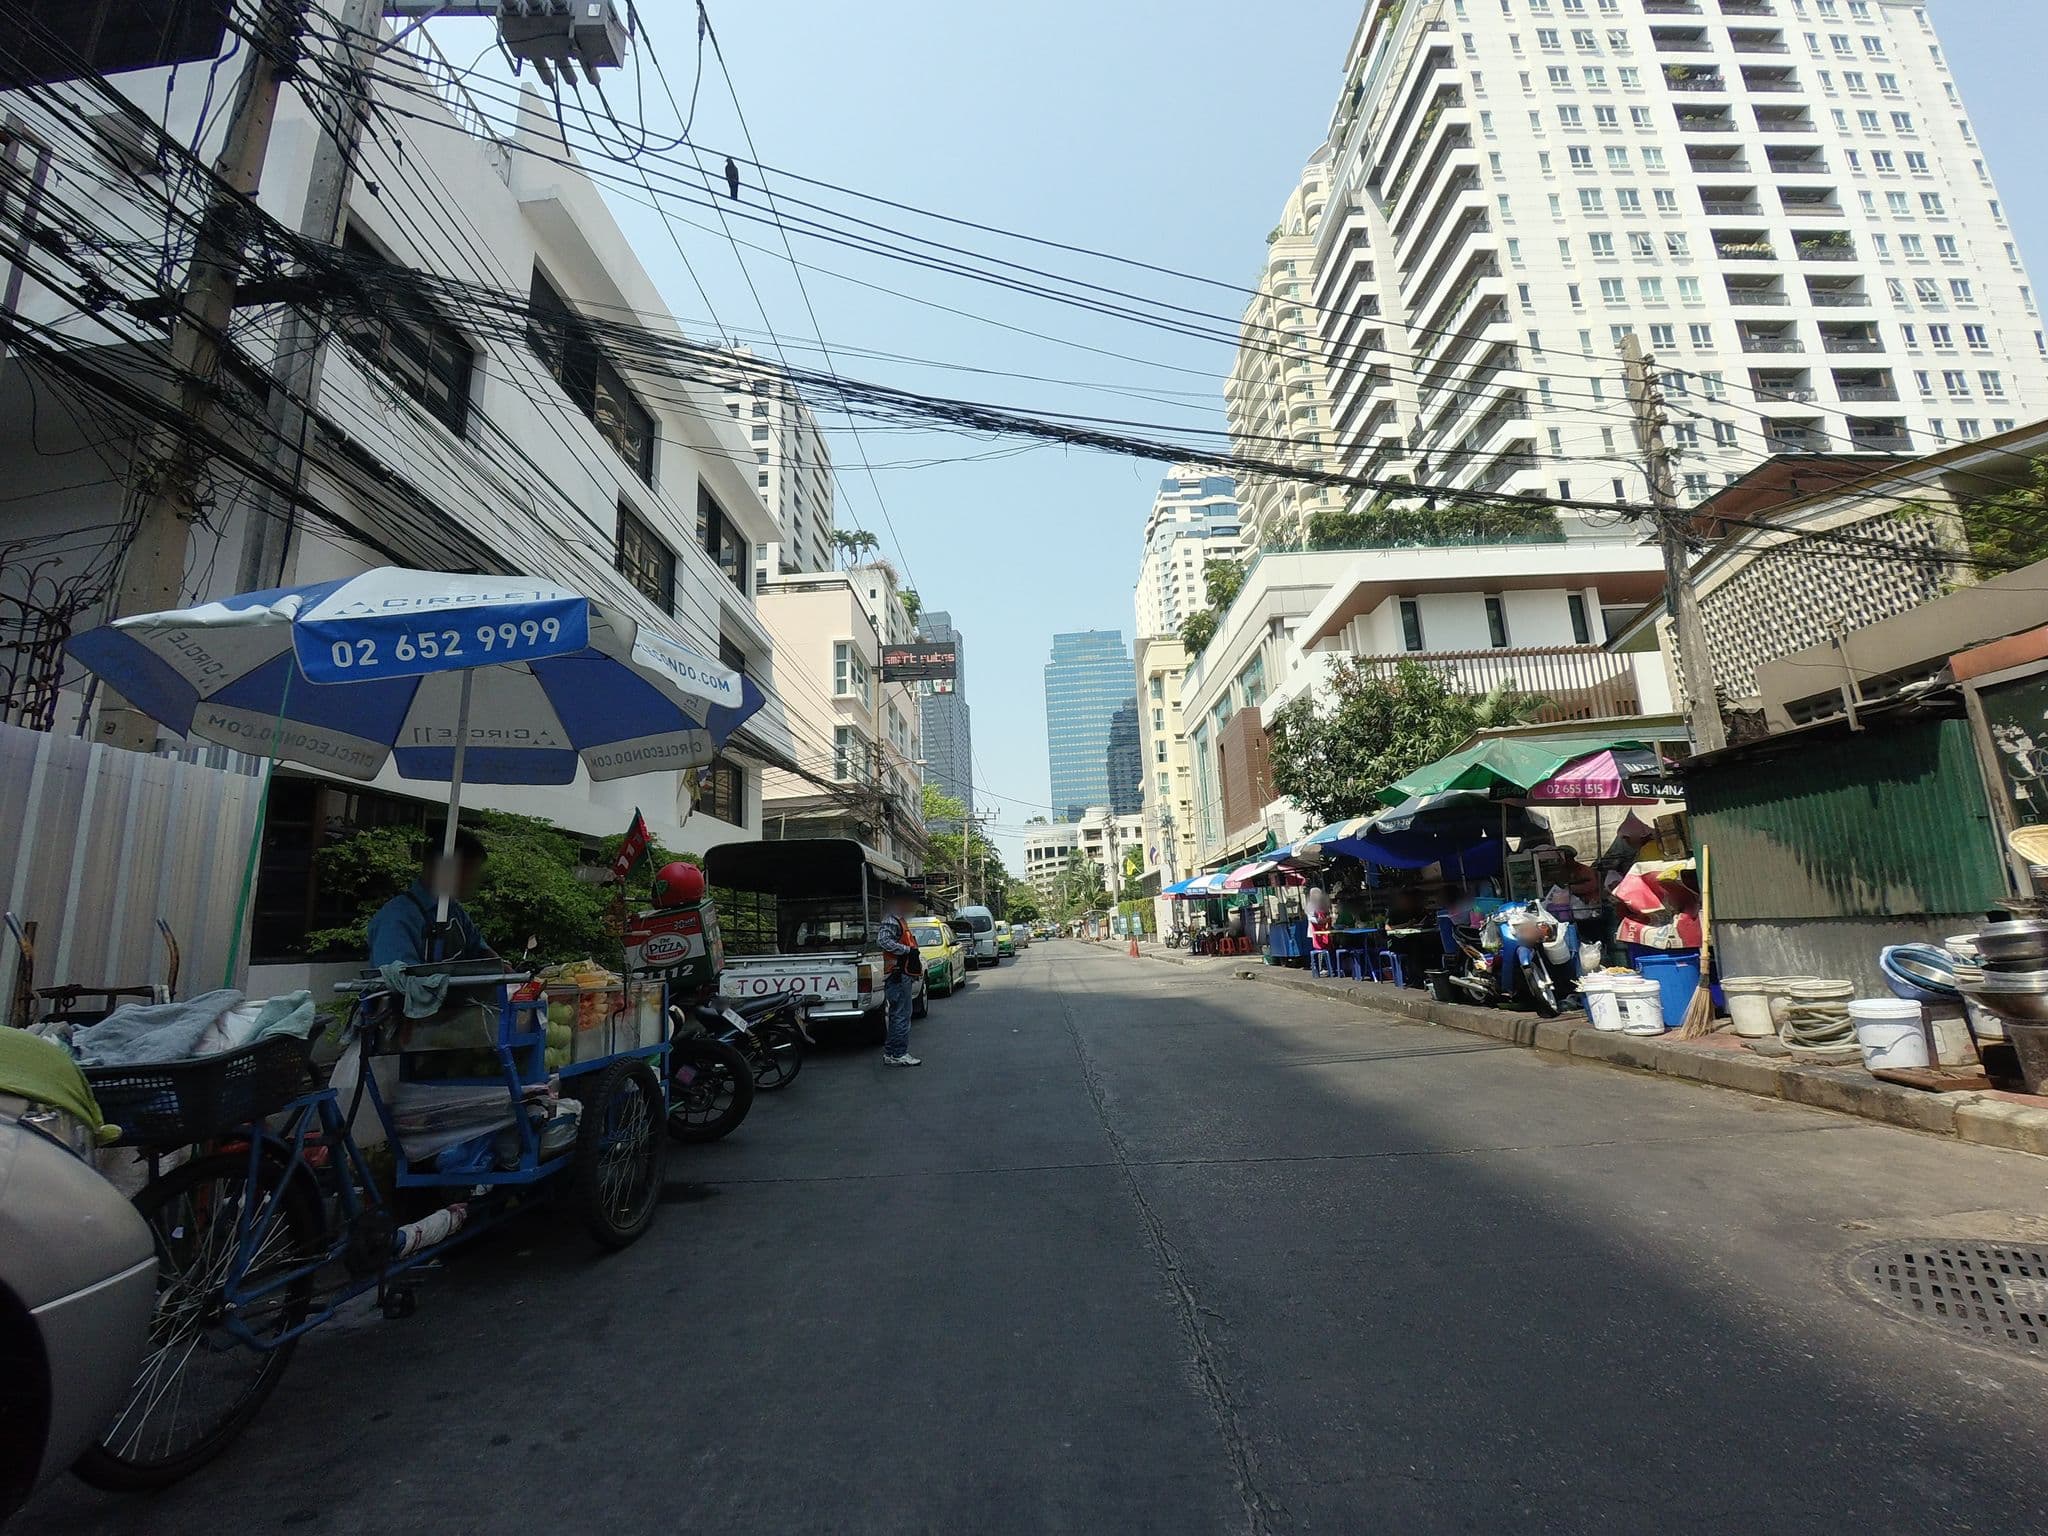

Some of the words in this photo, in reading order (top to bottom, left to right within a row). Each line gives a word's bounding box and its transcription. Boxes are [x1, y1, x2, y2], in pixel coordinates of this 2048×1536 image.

[331, 638, 379, 668] 02
[395, 630, 464, 661] 652
[476, 617, 561, 651] 9999
[1546, 783, 1560, 794] 02
[1562, 783, 1582, 794] 655
[1631, 783, 1650, 794] BTS
[737, 976, 840, 995] TOYOTA
